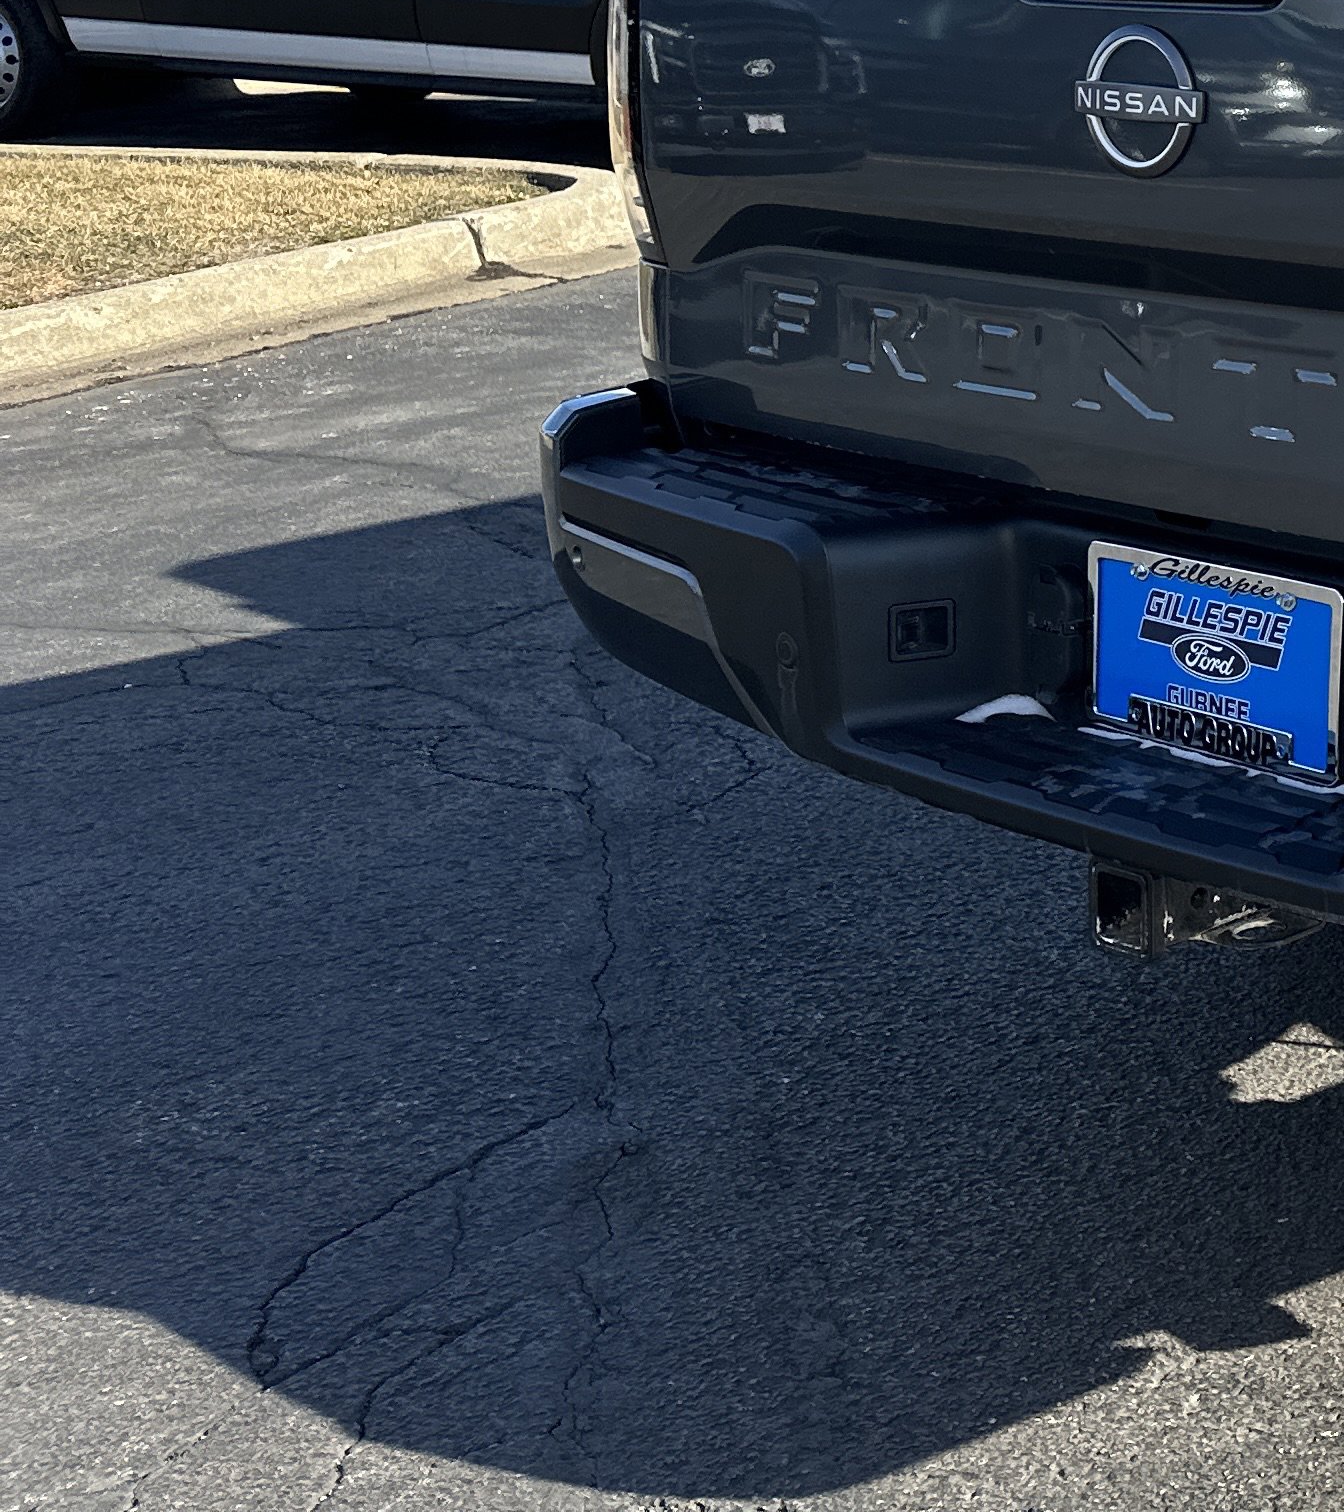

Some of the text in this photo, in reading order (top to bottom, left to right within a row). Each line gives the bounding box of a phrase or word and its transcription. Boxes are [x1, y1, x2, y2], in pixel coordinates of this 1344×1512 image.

[1077, 86, 1197, 118] NISSAN
[1149, 558, 1276, 599] Gillespie
[1144, 588, 1293, 645] GILLESPIE
[1184, 639, 1234, 676] Ford
[1166, 683, 1250, 721] GURNEE
[1135, 703, 1277, 764] AUTO GROUP
